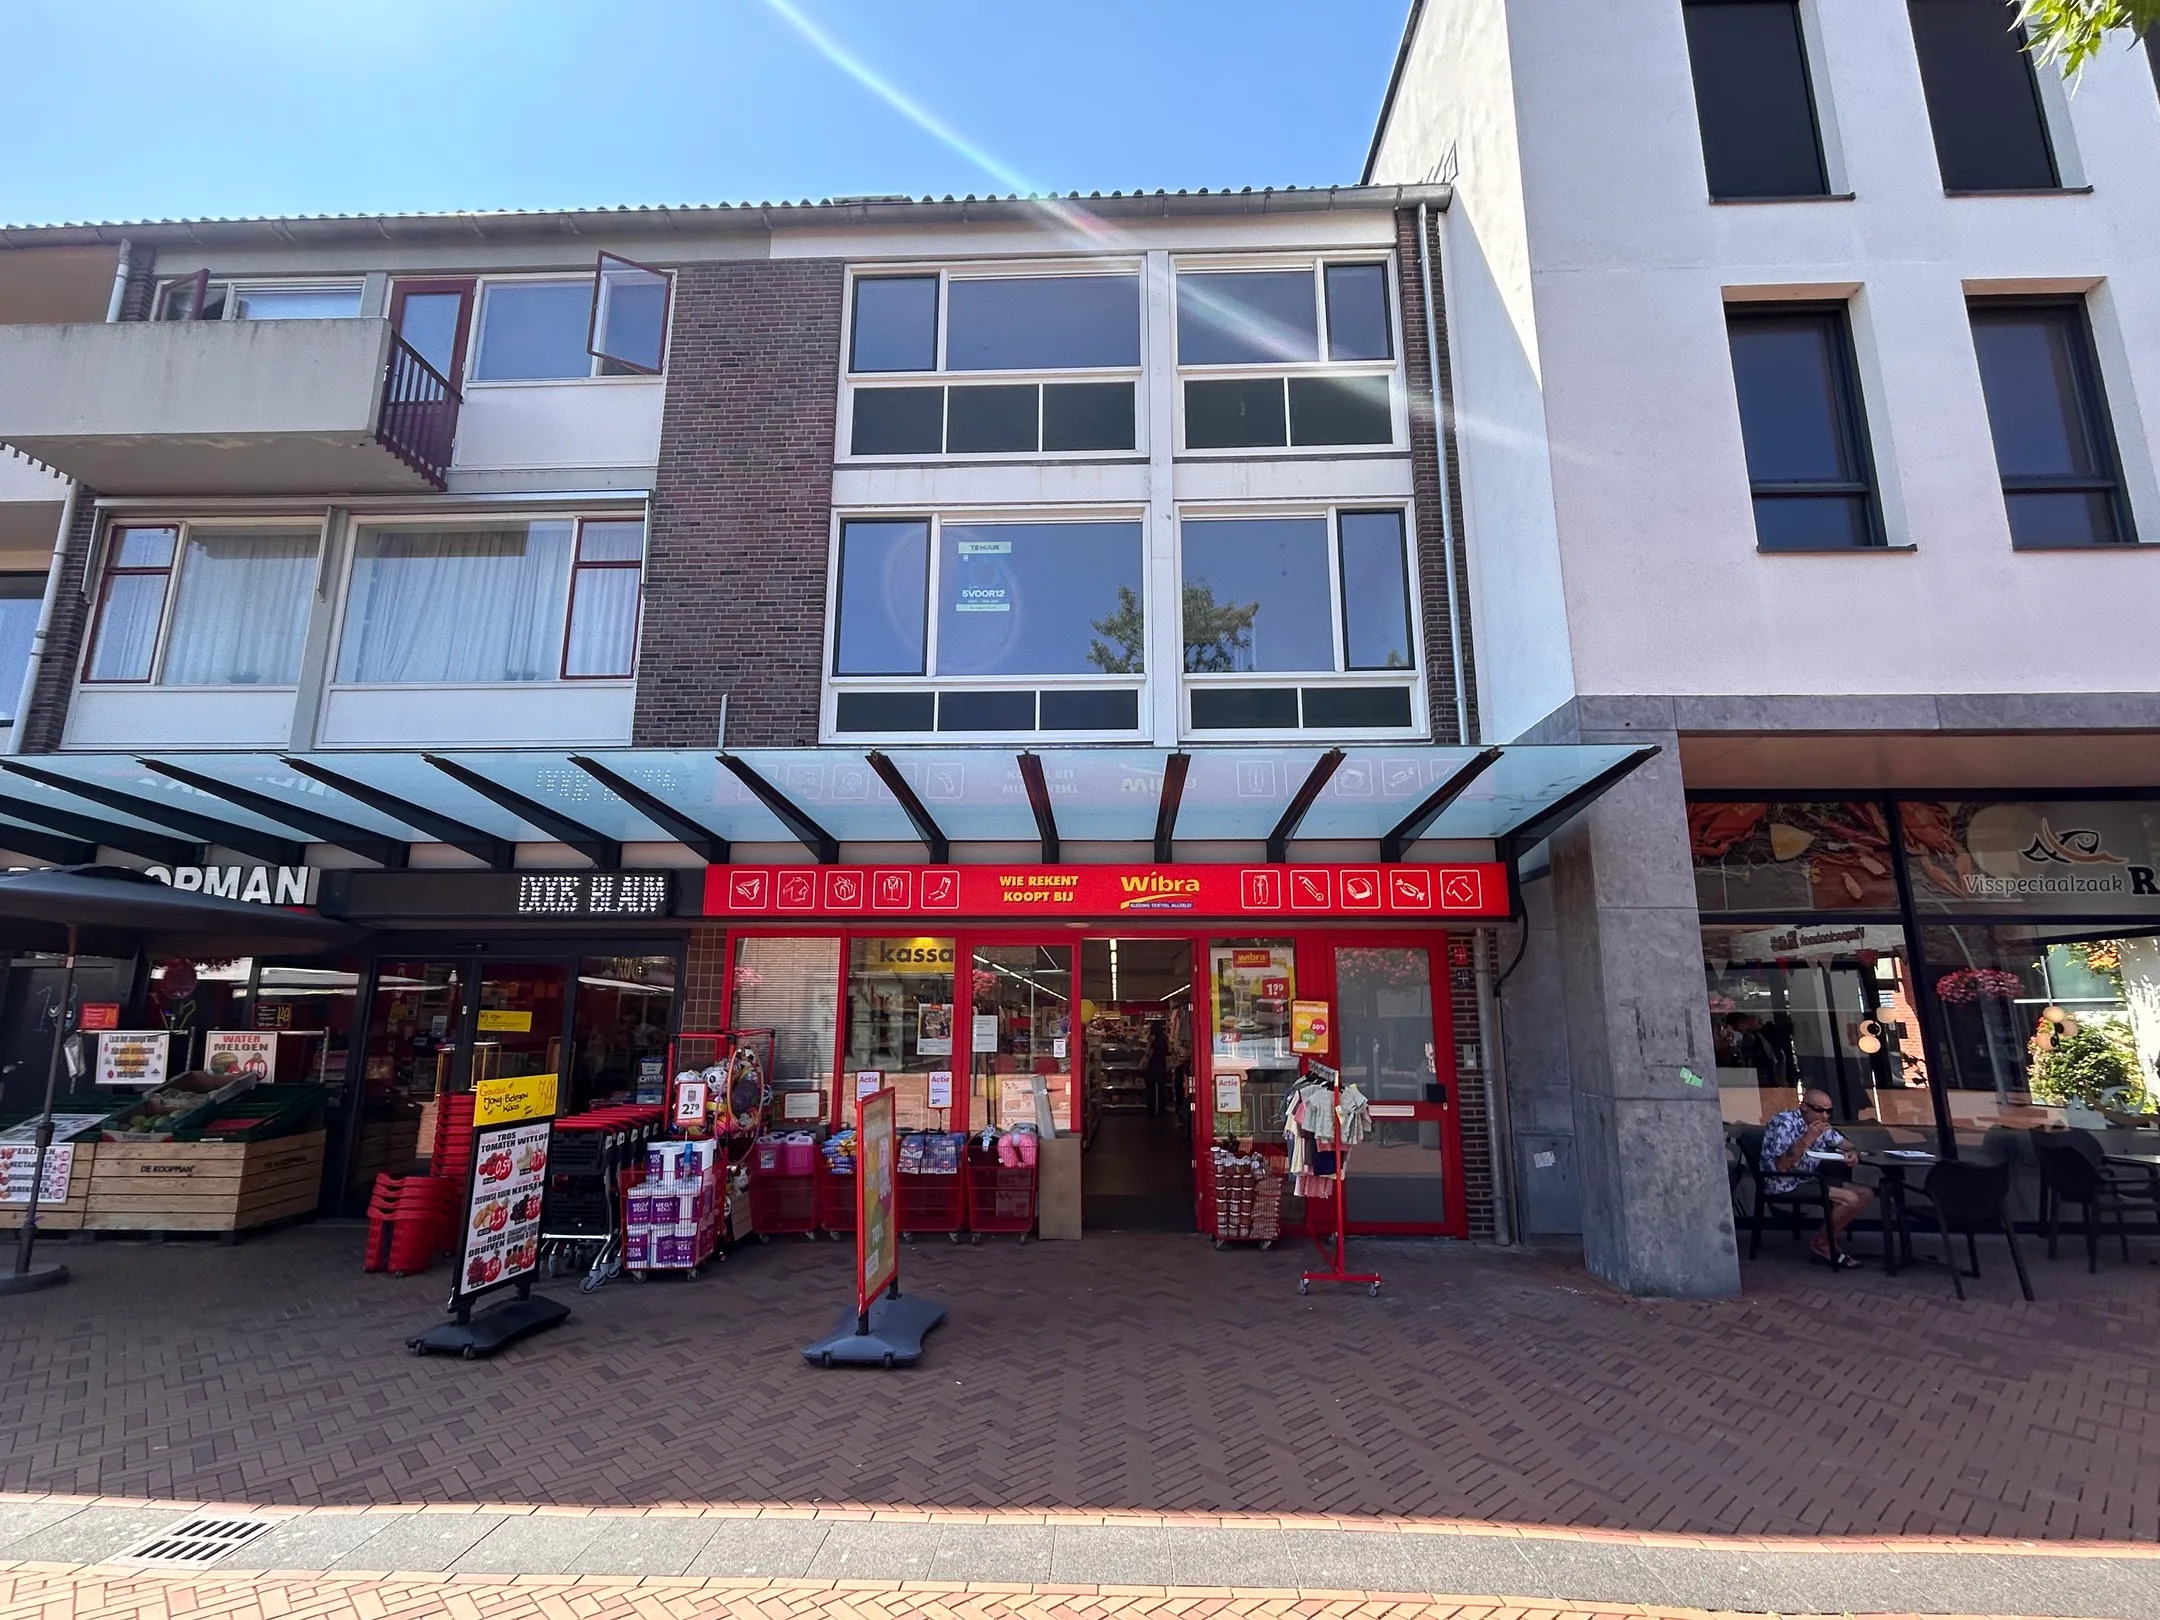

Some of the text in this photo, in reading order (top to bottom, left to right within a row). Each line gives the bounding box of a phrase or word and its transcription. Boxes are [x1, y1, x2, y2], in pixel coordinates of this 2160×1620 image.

[962, 589, 1006, 598] 5VOOR12
[999, 875, 1079, 887] WIE REKENT
[1120, 871, 1201, 892] Wibra
[1964, 874, 2123, 896] Visspeciaalzaak
[1003, 891, 1075, 903] KOOPT BIJ
[879, 940, 954, 963] kassa
[222, 1035, 261, 1043] WATER
[214, 1043, 268, 1051] MELOEN
[859, 1075, 878, 1083] Actie
[931, 1075, 950, 1083] Actie
[1218, 1079, 1238, 1087] Actie
[681, 1103, 700, 1116] 2.79
[497, 1131, 517, 1142] TROS
[481, 1140, 516, 1153] TOMATEN
[517, 1132, 549, 1145] WITLOF
[140, 1165, 193, 1173] DE KOOPMAN
[468, 1239, 506, 1258] DRUIVEN
